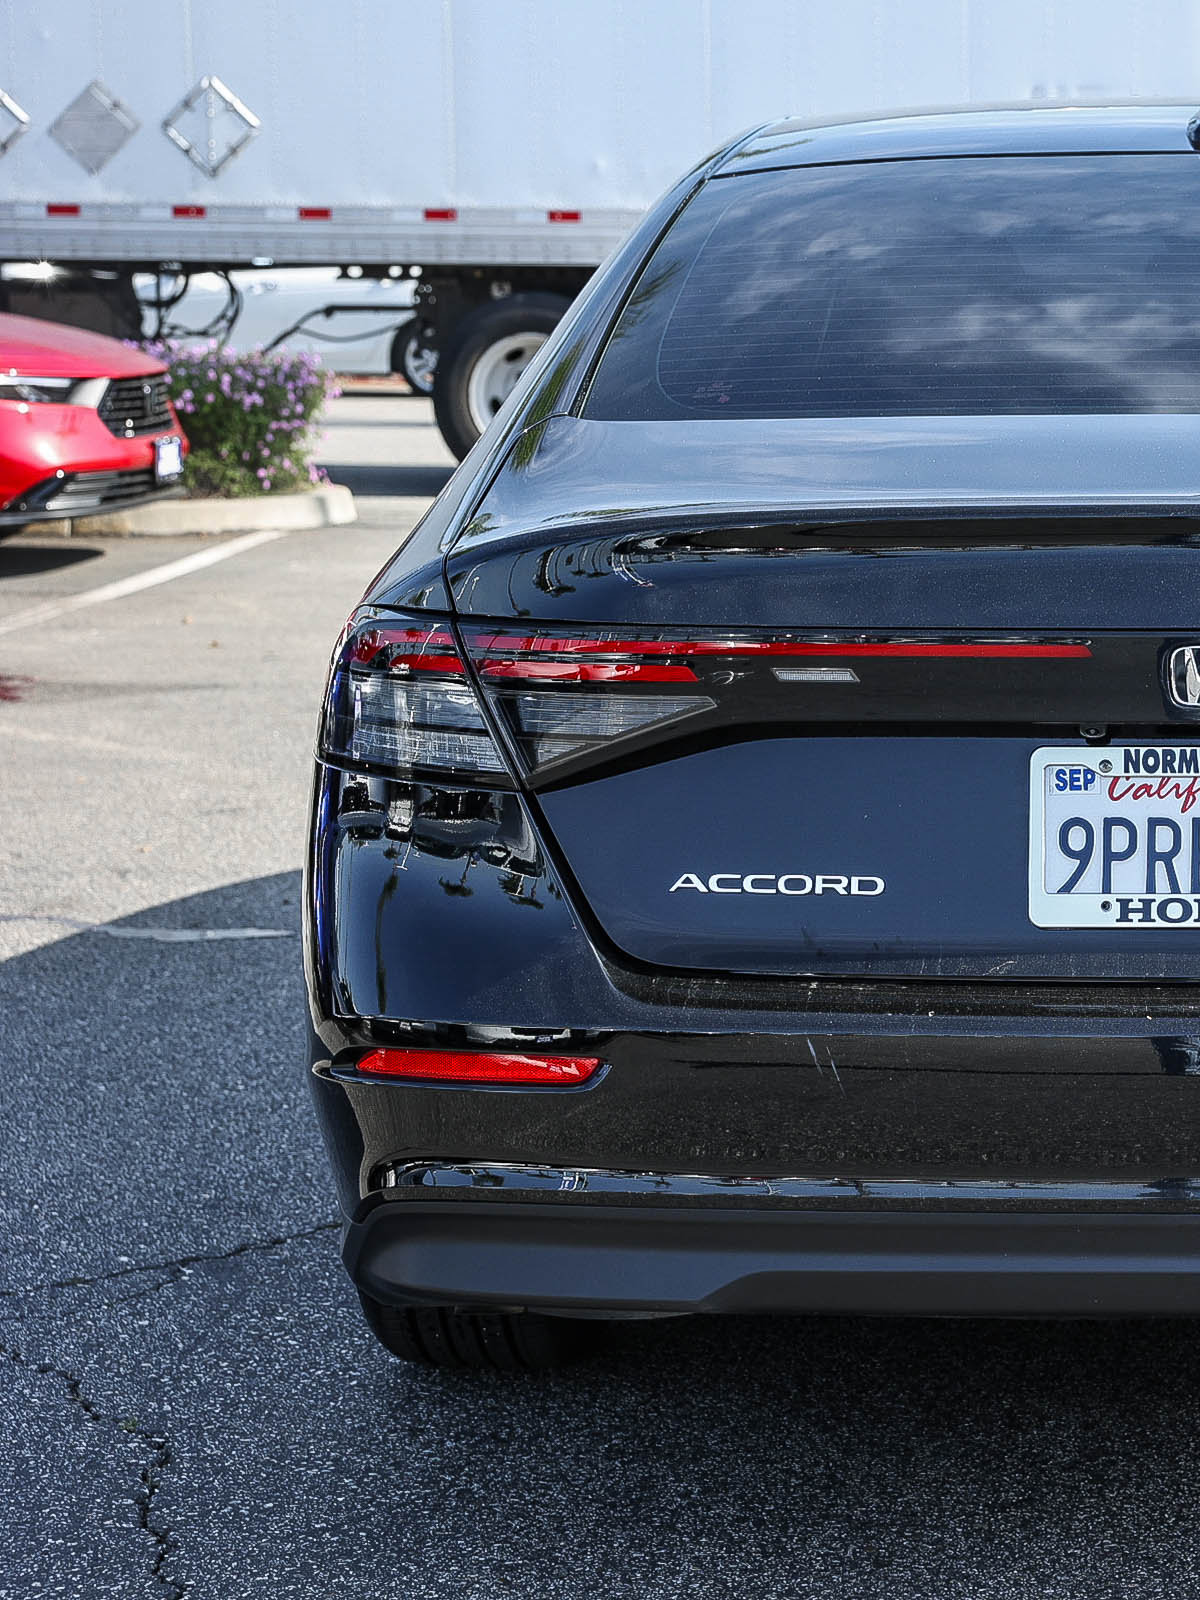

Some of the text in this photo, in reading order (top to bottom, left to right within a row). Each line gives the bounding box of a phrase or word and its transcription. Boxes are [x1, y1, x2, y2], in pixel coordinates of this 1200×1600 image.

[1123, 749, 1199, 774] NORM
[1054, 769, 1096, 792] SEP
[669, 873, 885, 896] ACCORD
